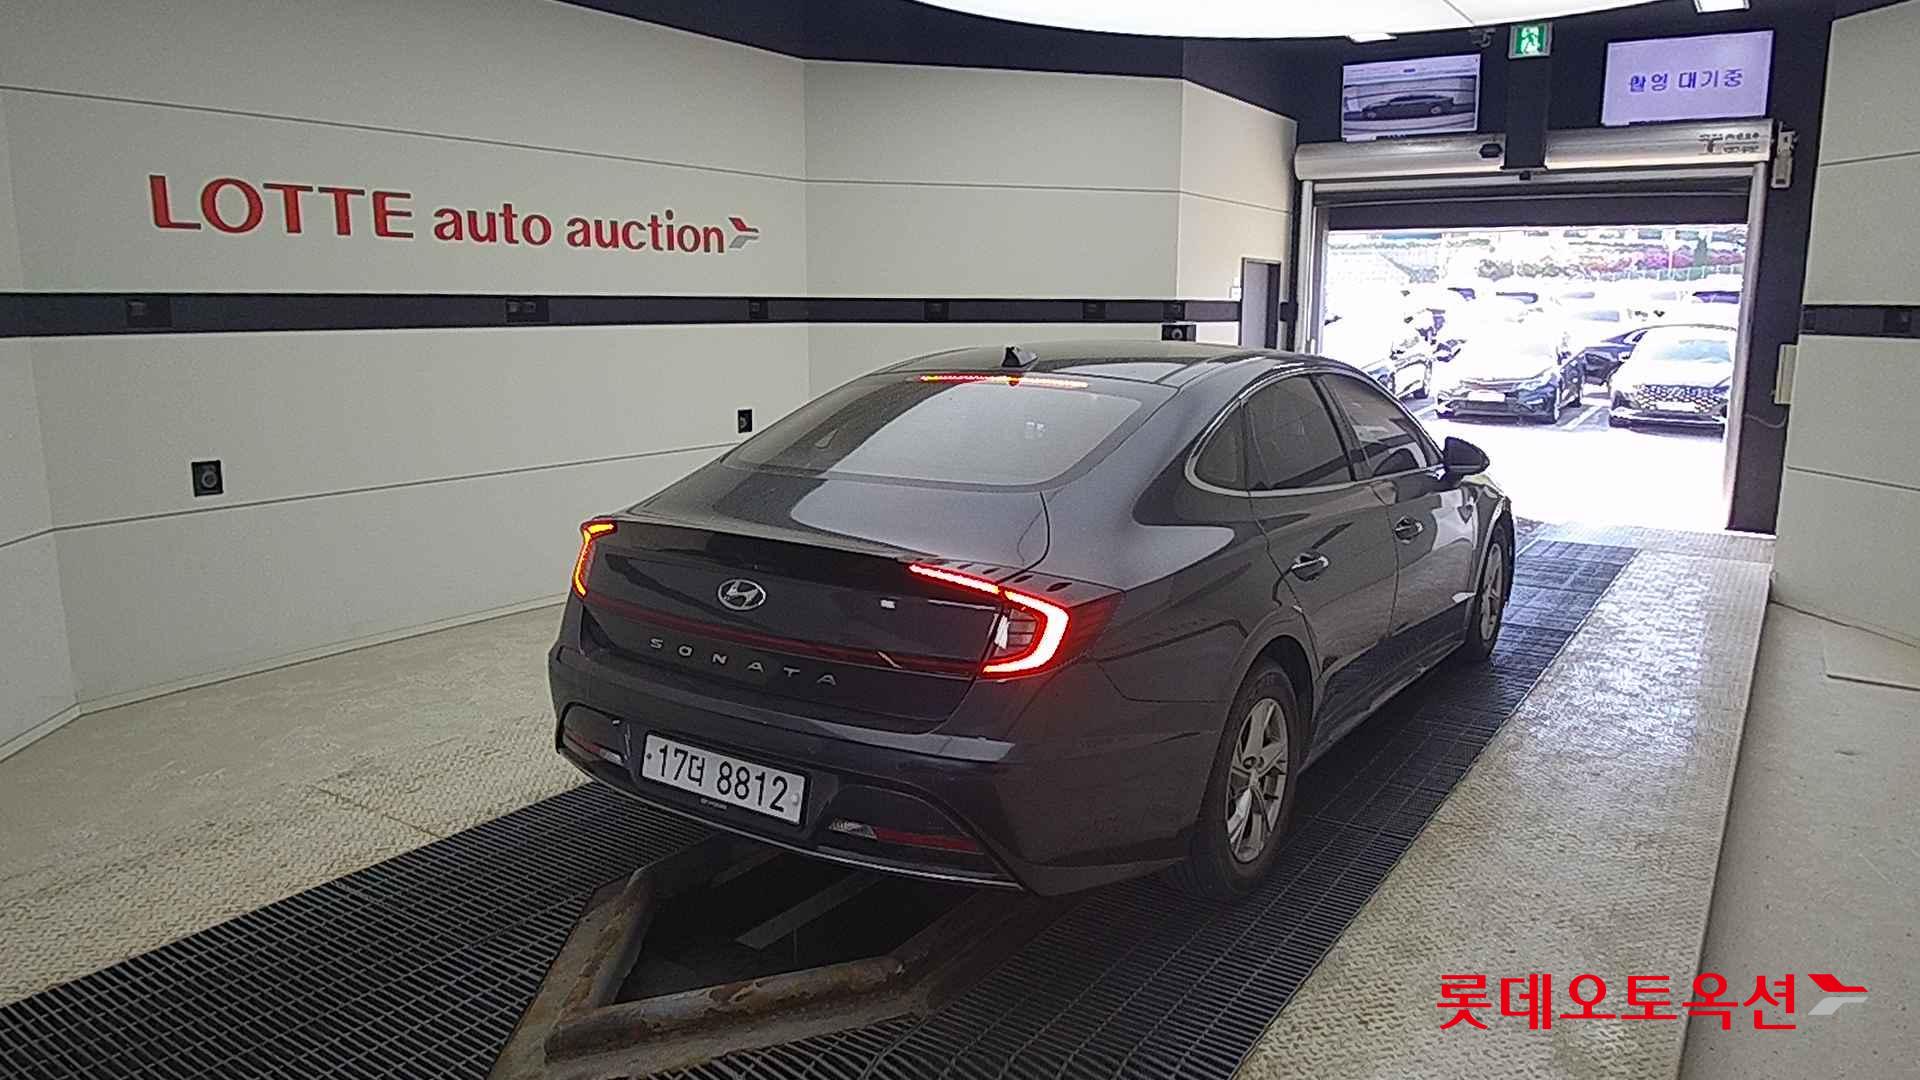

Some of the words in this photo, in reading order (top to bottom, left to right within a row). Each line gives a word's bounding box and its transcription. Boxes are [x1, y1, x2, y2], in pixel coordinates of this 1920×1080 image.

[1678, 69, 1743, 88] 대기중
[149, 175, 414, 238] LOTTE
[433, 203, 552, 246] auto
[566, 210, 725, 254] auction
[650, 637, 837, 686] SONATA
[659, 744, 705, 787] 17더
[716, 761, 788, 813] 8812
